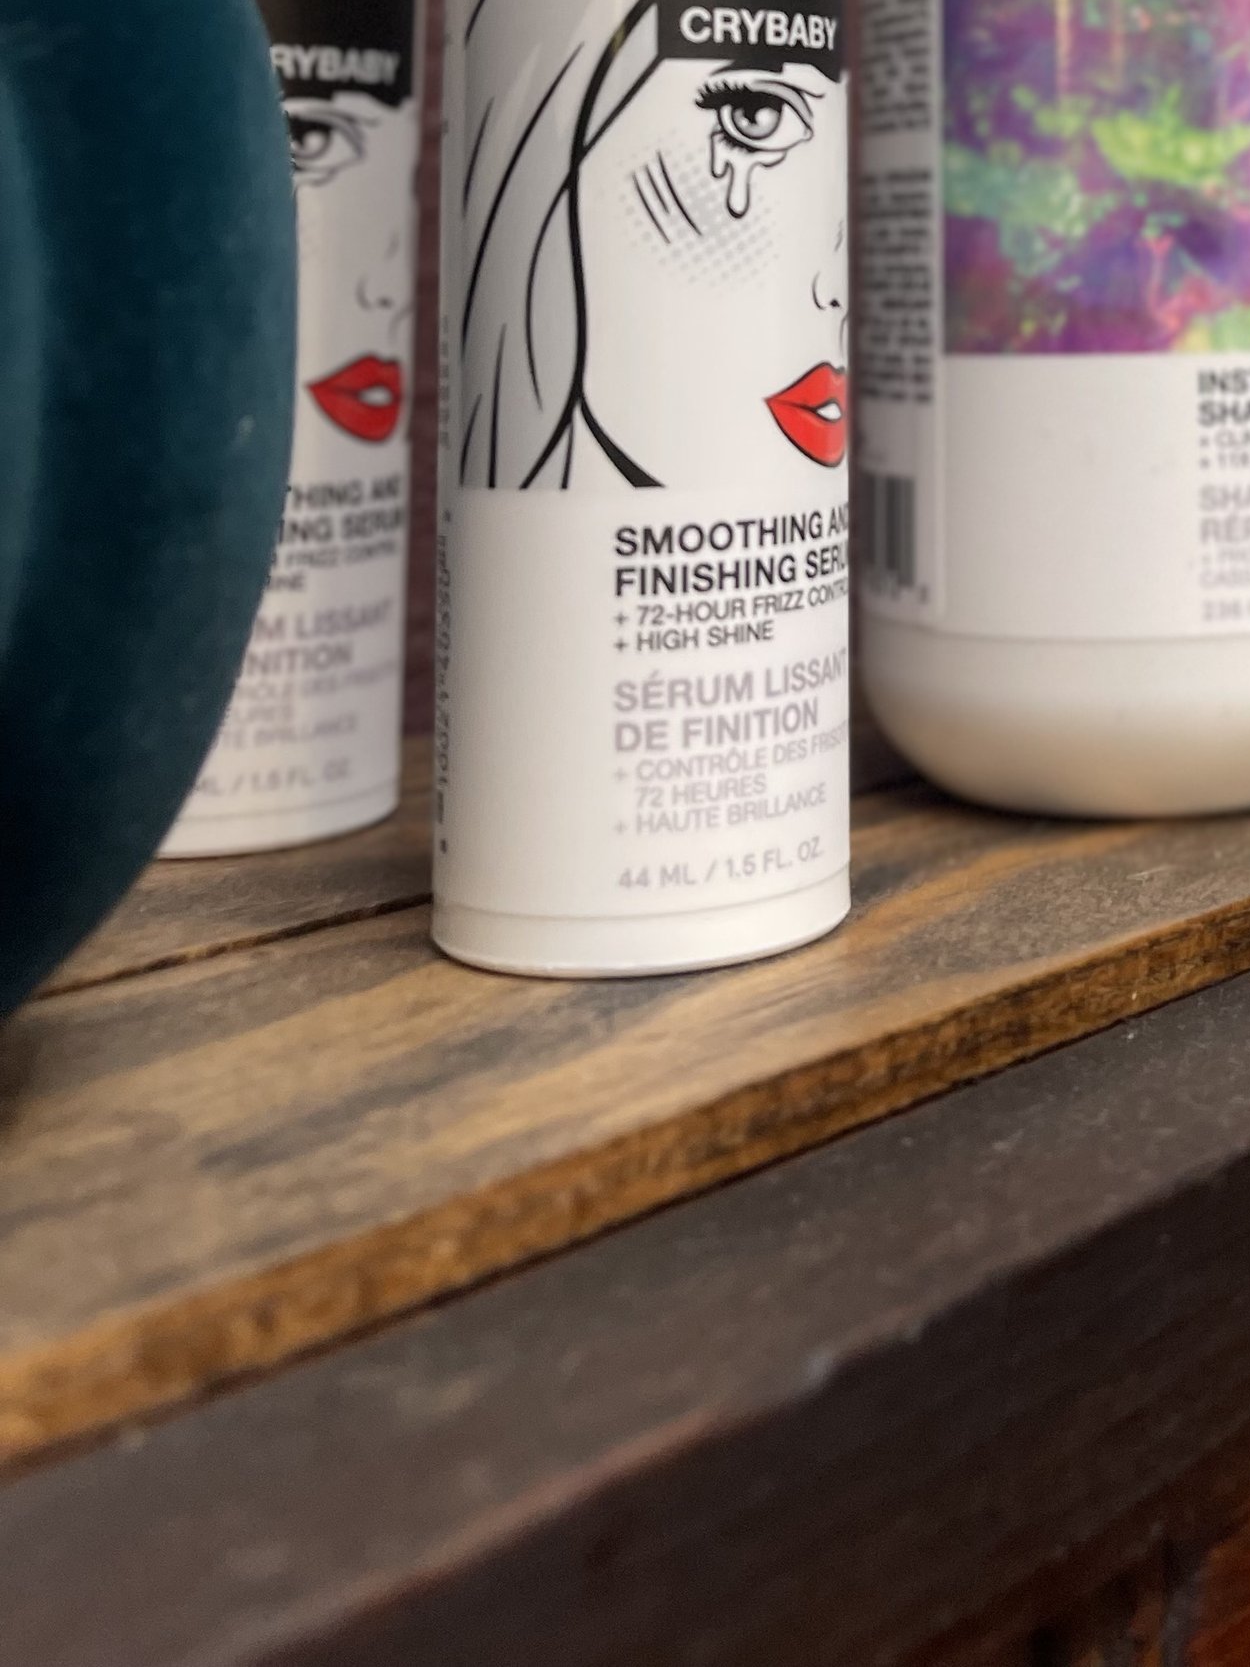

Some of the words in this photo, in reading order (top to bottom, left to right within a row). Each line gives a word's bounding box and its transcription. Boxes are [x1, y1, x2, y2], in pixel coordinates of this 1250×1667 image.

[680, 5, 837, 51] CRYBABY
[270, 43, 400, 84] RYBABY
[615, 510, 822, 557] SMOOTHING
[615, 554, 796, 597] FINISHING
[637, 595, 745, 626] 72-HOUR
[752, 589, 804, 617] FRIZZ
[637, 627, 699, 652] HIGH
[708, 620, 774, 647] SHINE
[614, 669, 753, 713] SÉRUM
[615, 720, 670, 752] DE
[683, 697, 819, 749] FINITION
[635, 745, 768, 782] CONTRÔLE
[773, 736, 807, 764] DES
[635, 786, 665, 808] 72
[672, 774, 767, 806] HEURES
[636, 806, 720, 835] HAUTE
[727, 781, 826, 825] BRILLANCE
[618, 867, 650, 889] 44
[659, 863, 697, 887] ML
[725, 852, 757, 879] 1.5
[763, 847, 793, 873] FL.
